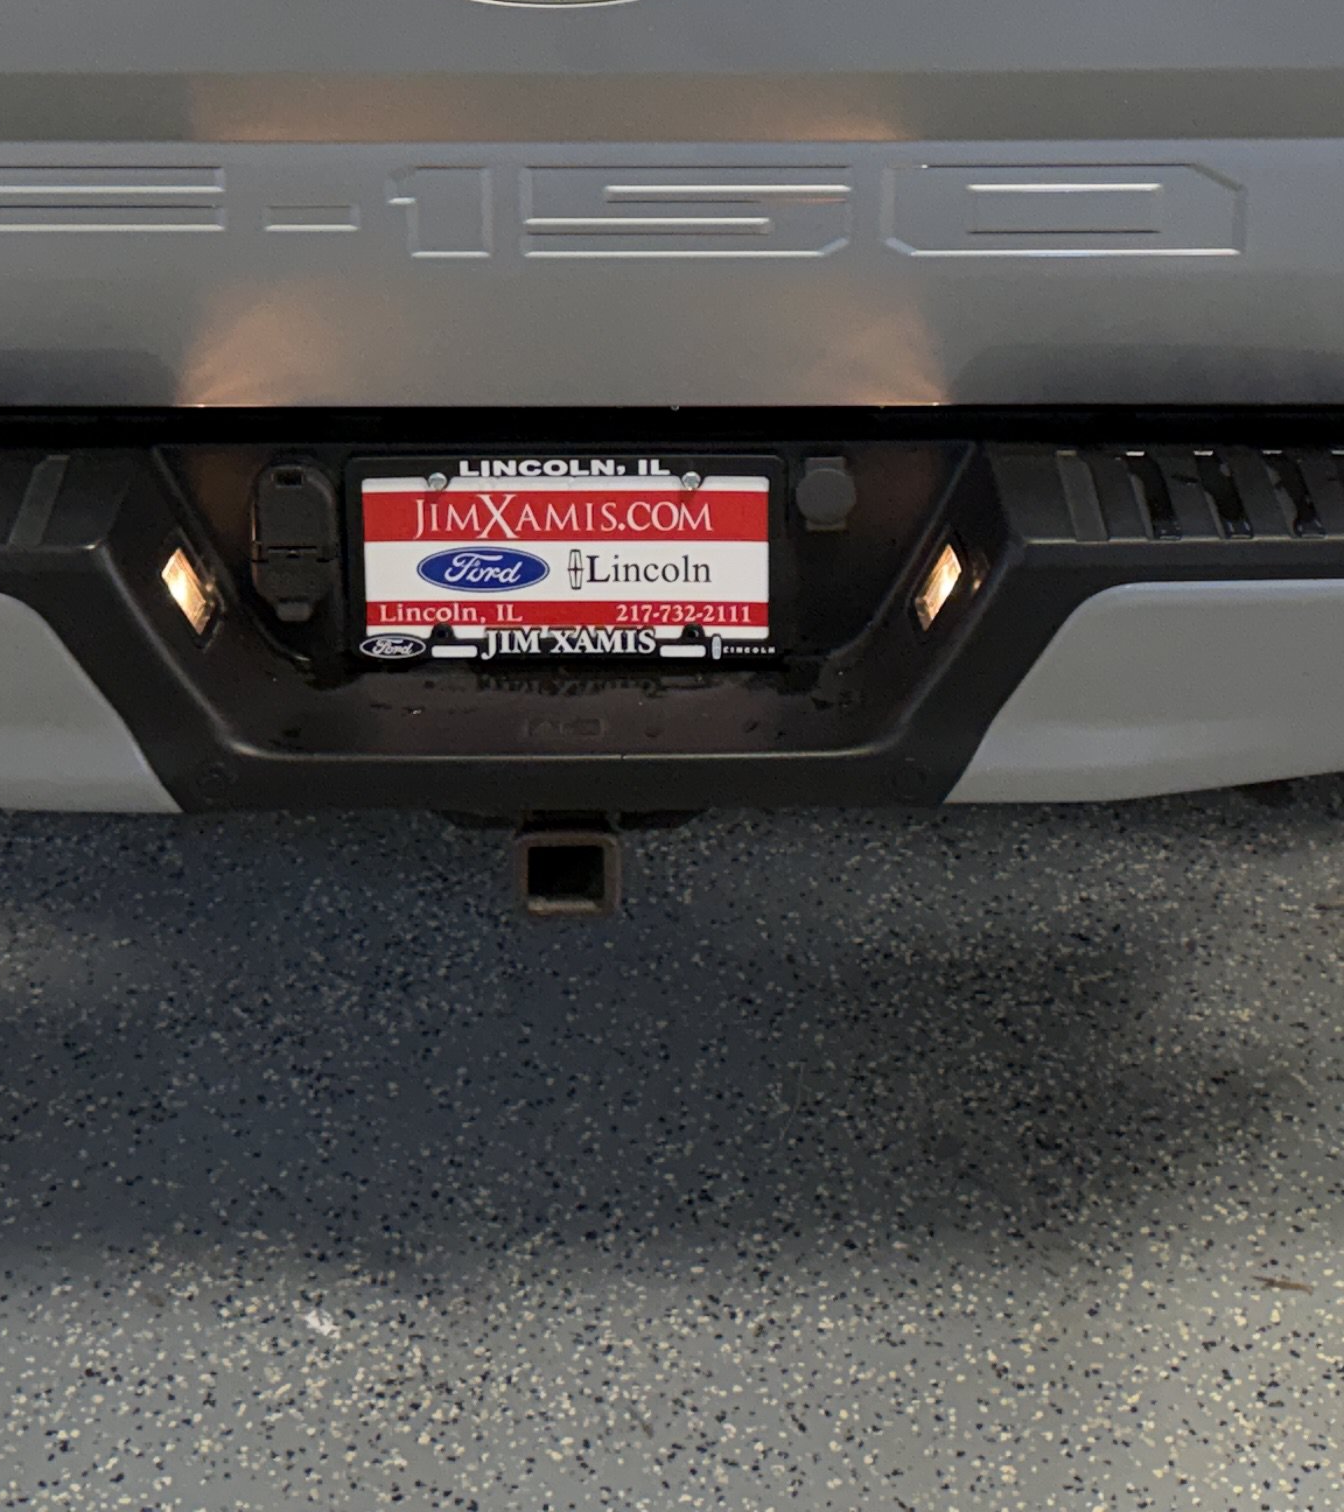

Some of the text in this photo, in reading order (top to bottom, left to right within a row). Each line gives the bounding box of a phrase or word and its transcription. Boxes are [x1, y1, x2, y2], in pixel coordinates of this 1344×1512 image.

[459, 459, 671, 477] LINCOLN, IL
[444, 553, 521, 584] Ford
[586, 555, 712, 583] Lincoln
[379, 603, 523, 623] Lincoln, IL
[615, 604, 751, 623] 217-732-2111
[371, 639, 415, 655] Ford
[481, 628, 657, 660] JIM XAMIS
